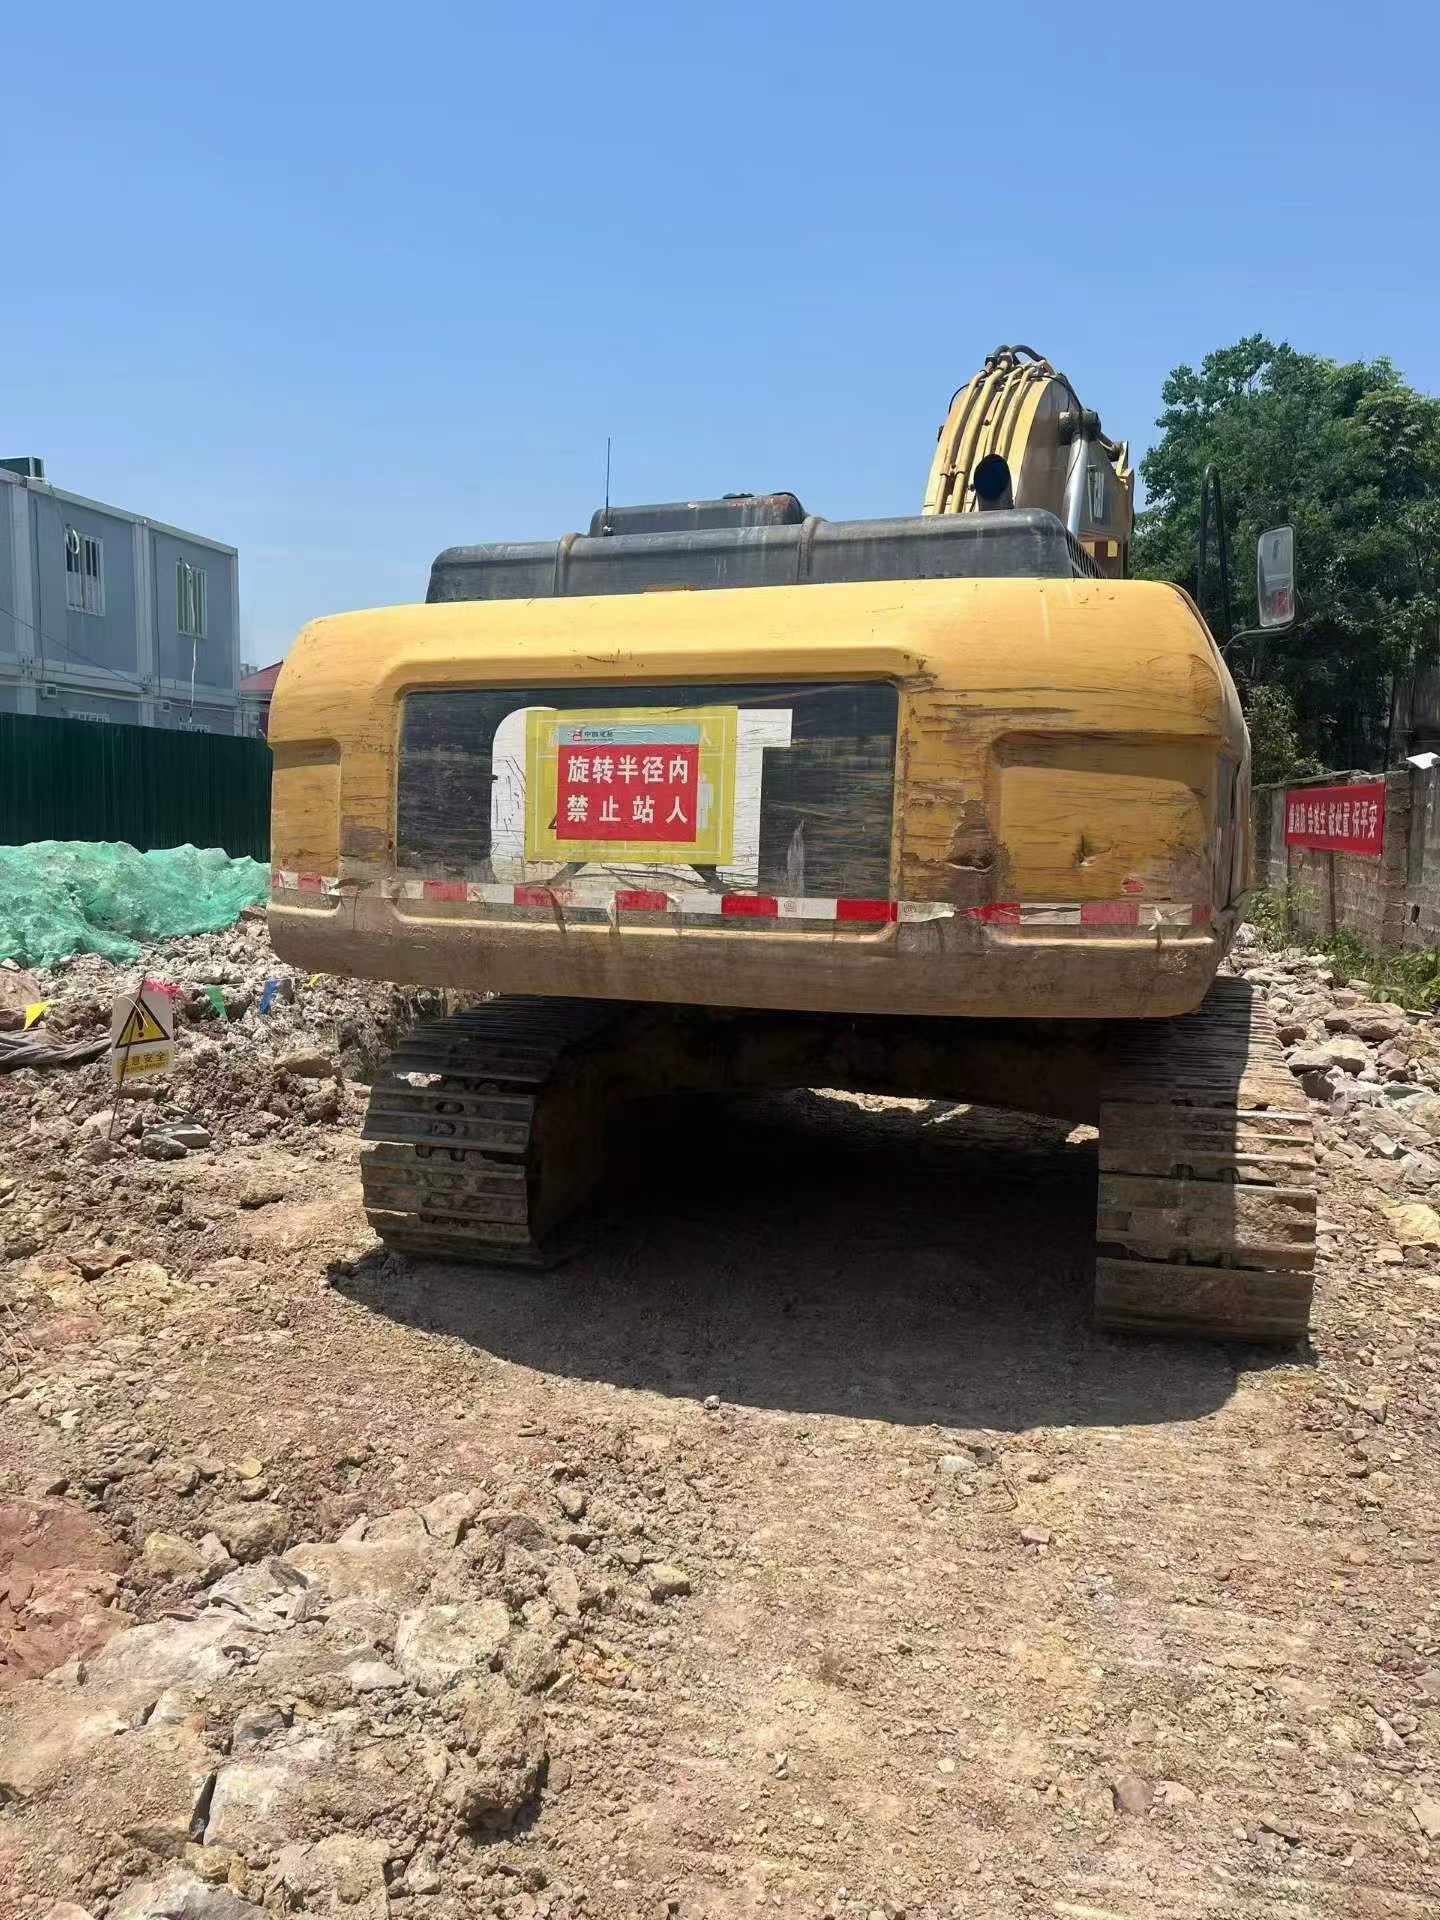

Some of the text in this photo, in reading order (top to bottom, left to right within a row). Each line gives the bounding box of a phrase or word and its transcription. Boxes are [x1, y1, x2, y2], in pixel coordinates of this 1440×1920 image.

[567, 754, 689, 785] 旋转半径内
[567, 794, 688, 825] 禁止站人
[1352, 800, 1377, 839] 保平安
